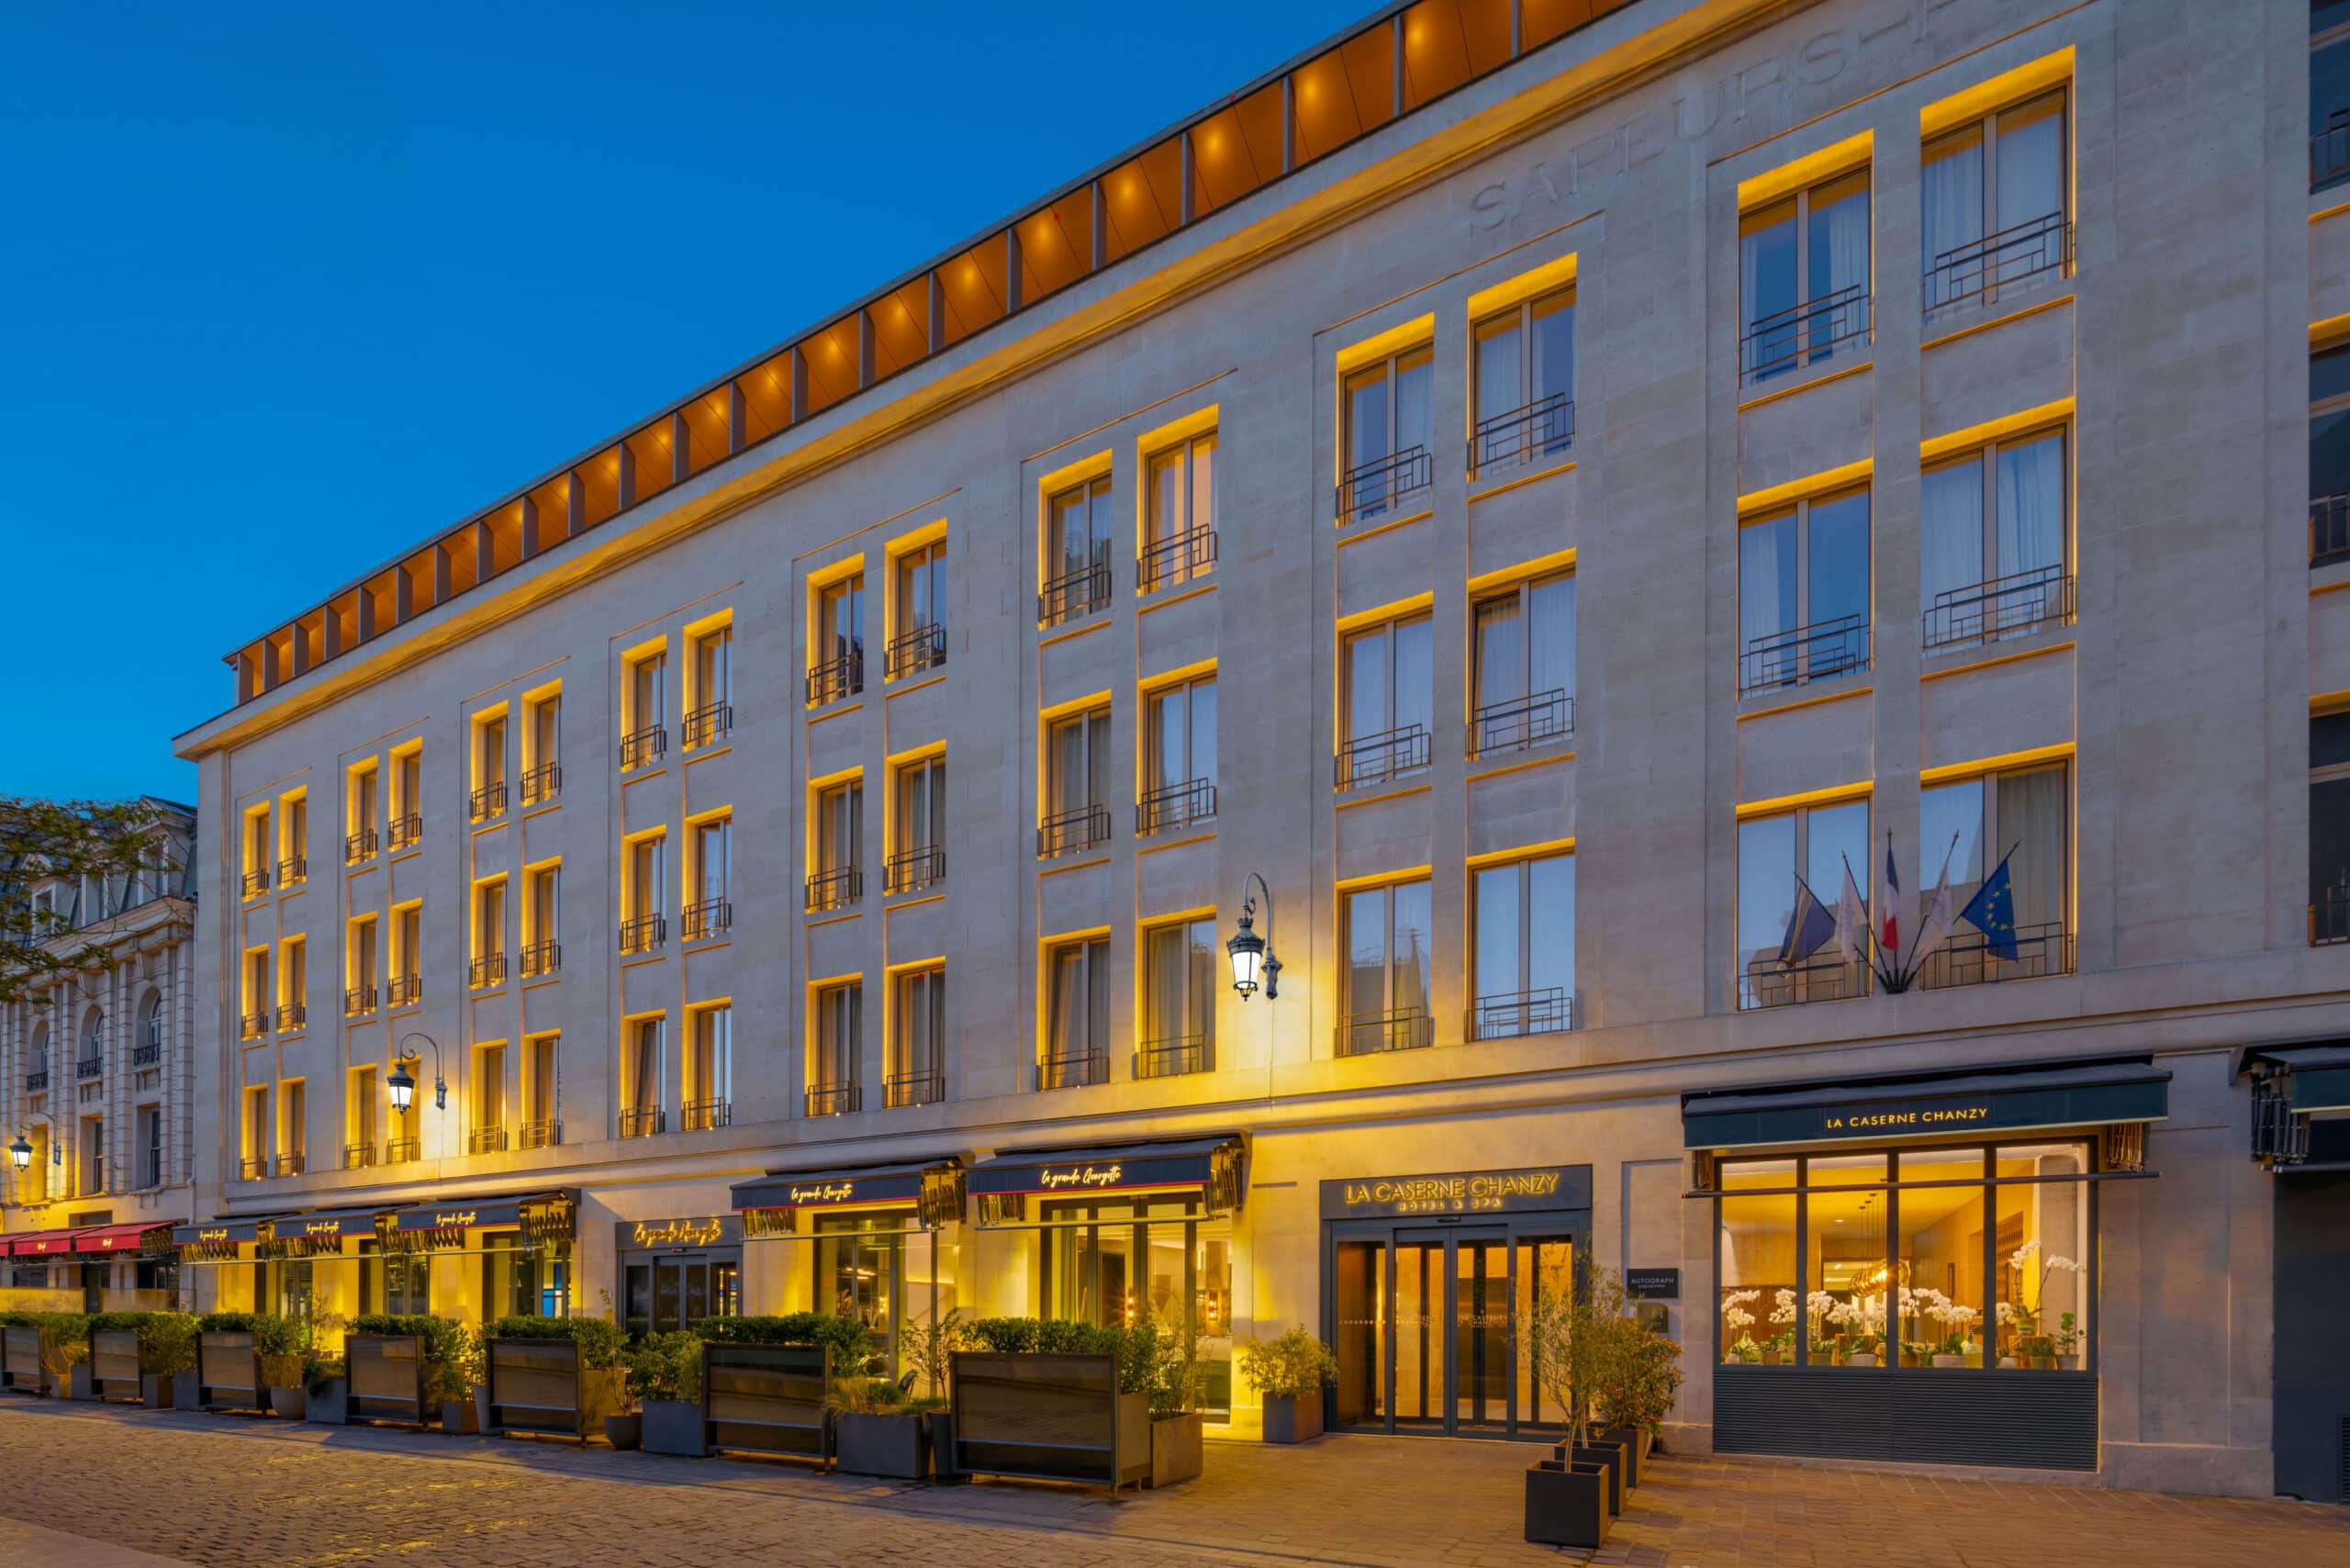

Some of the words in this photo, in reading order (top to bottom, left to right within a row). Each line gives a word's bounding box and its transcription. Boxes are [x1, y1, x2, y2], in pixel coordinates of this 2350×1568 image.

[1827, 1119, 1842, 1128] LA
[1850, 1113, 1917, 1127] CASERNE
[1922, 1108, 1987, 1122] CHANZY
[1051, 1168, 1080, 1189] grande
[1345, 1183, 1371, 1204] LA
[1373, 1178, 1465, 1204] CASERNE
[1470, 1173, 1559, 1197] CHANZY
[1472, 1197, 1502, 1209] SPA
